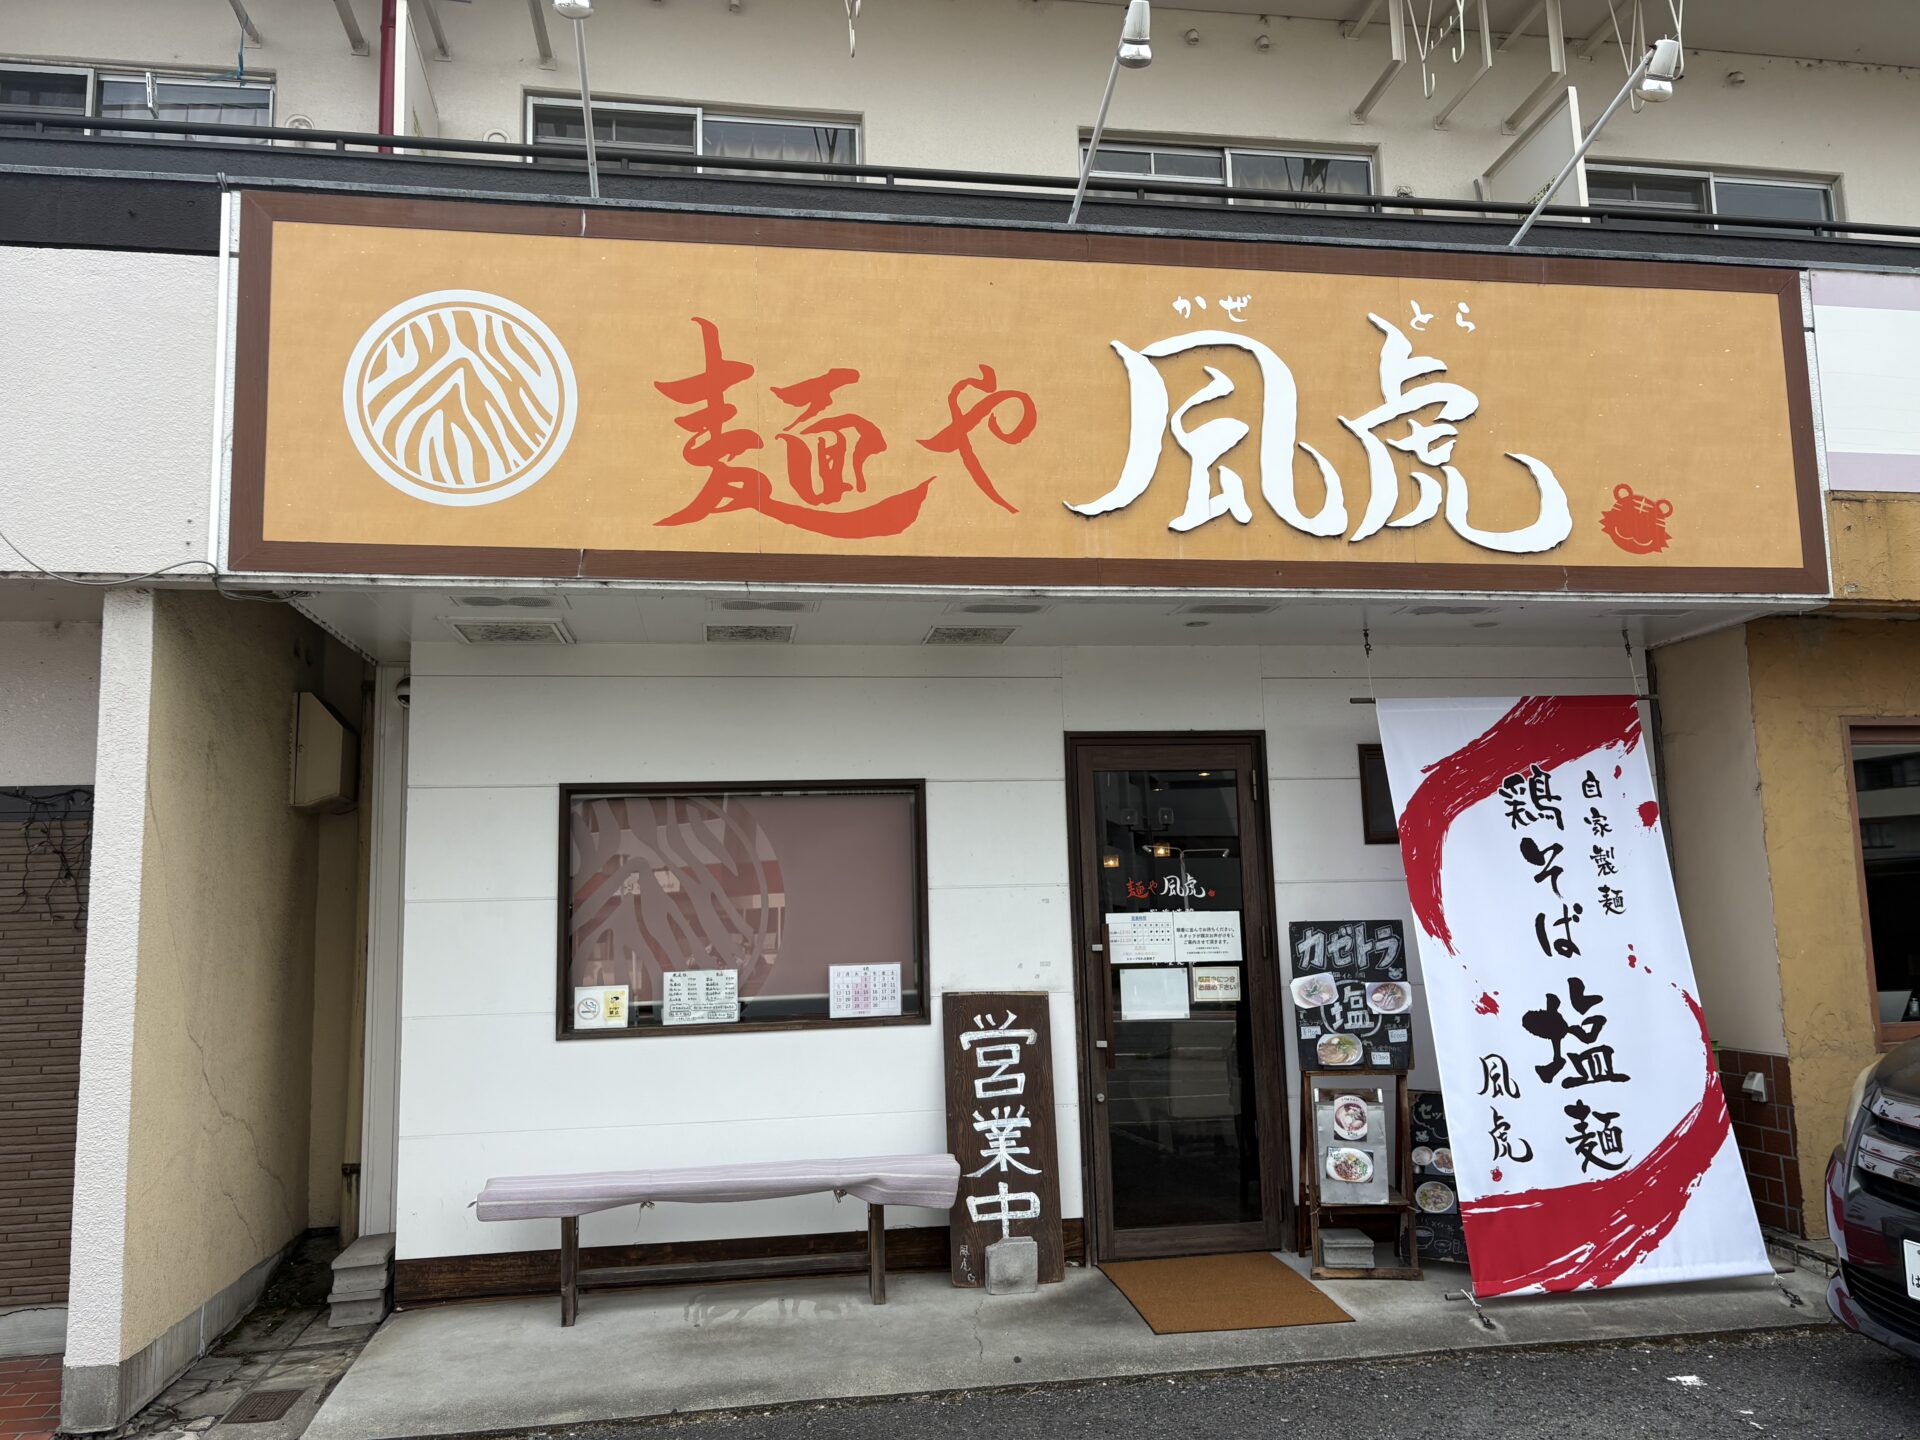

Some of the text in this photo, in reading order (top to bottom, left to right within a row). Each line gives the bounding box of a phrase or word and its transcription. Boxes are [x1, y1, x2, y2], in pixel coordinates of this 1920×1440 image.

[1172, 295, 1476, 333] かぜ とら
[1581, 770, 1626, 917] 自家製麺
[1296, 922, 1402, 970] カゼトラ
[1330, 985, 1375, 1031] 塩
[959, 1009, 1043, 1239] 営業中
[1476, 1053, 1534, 1163] 風虎
